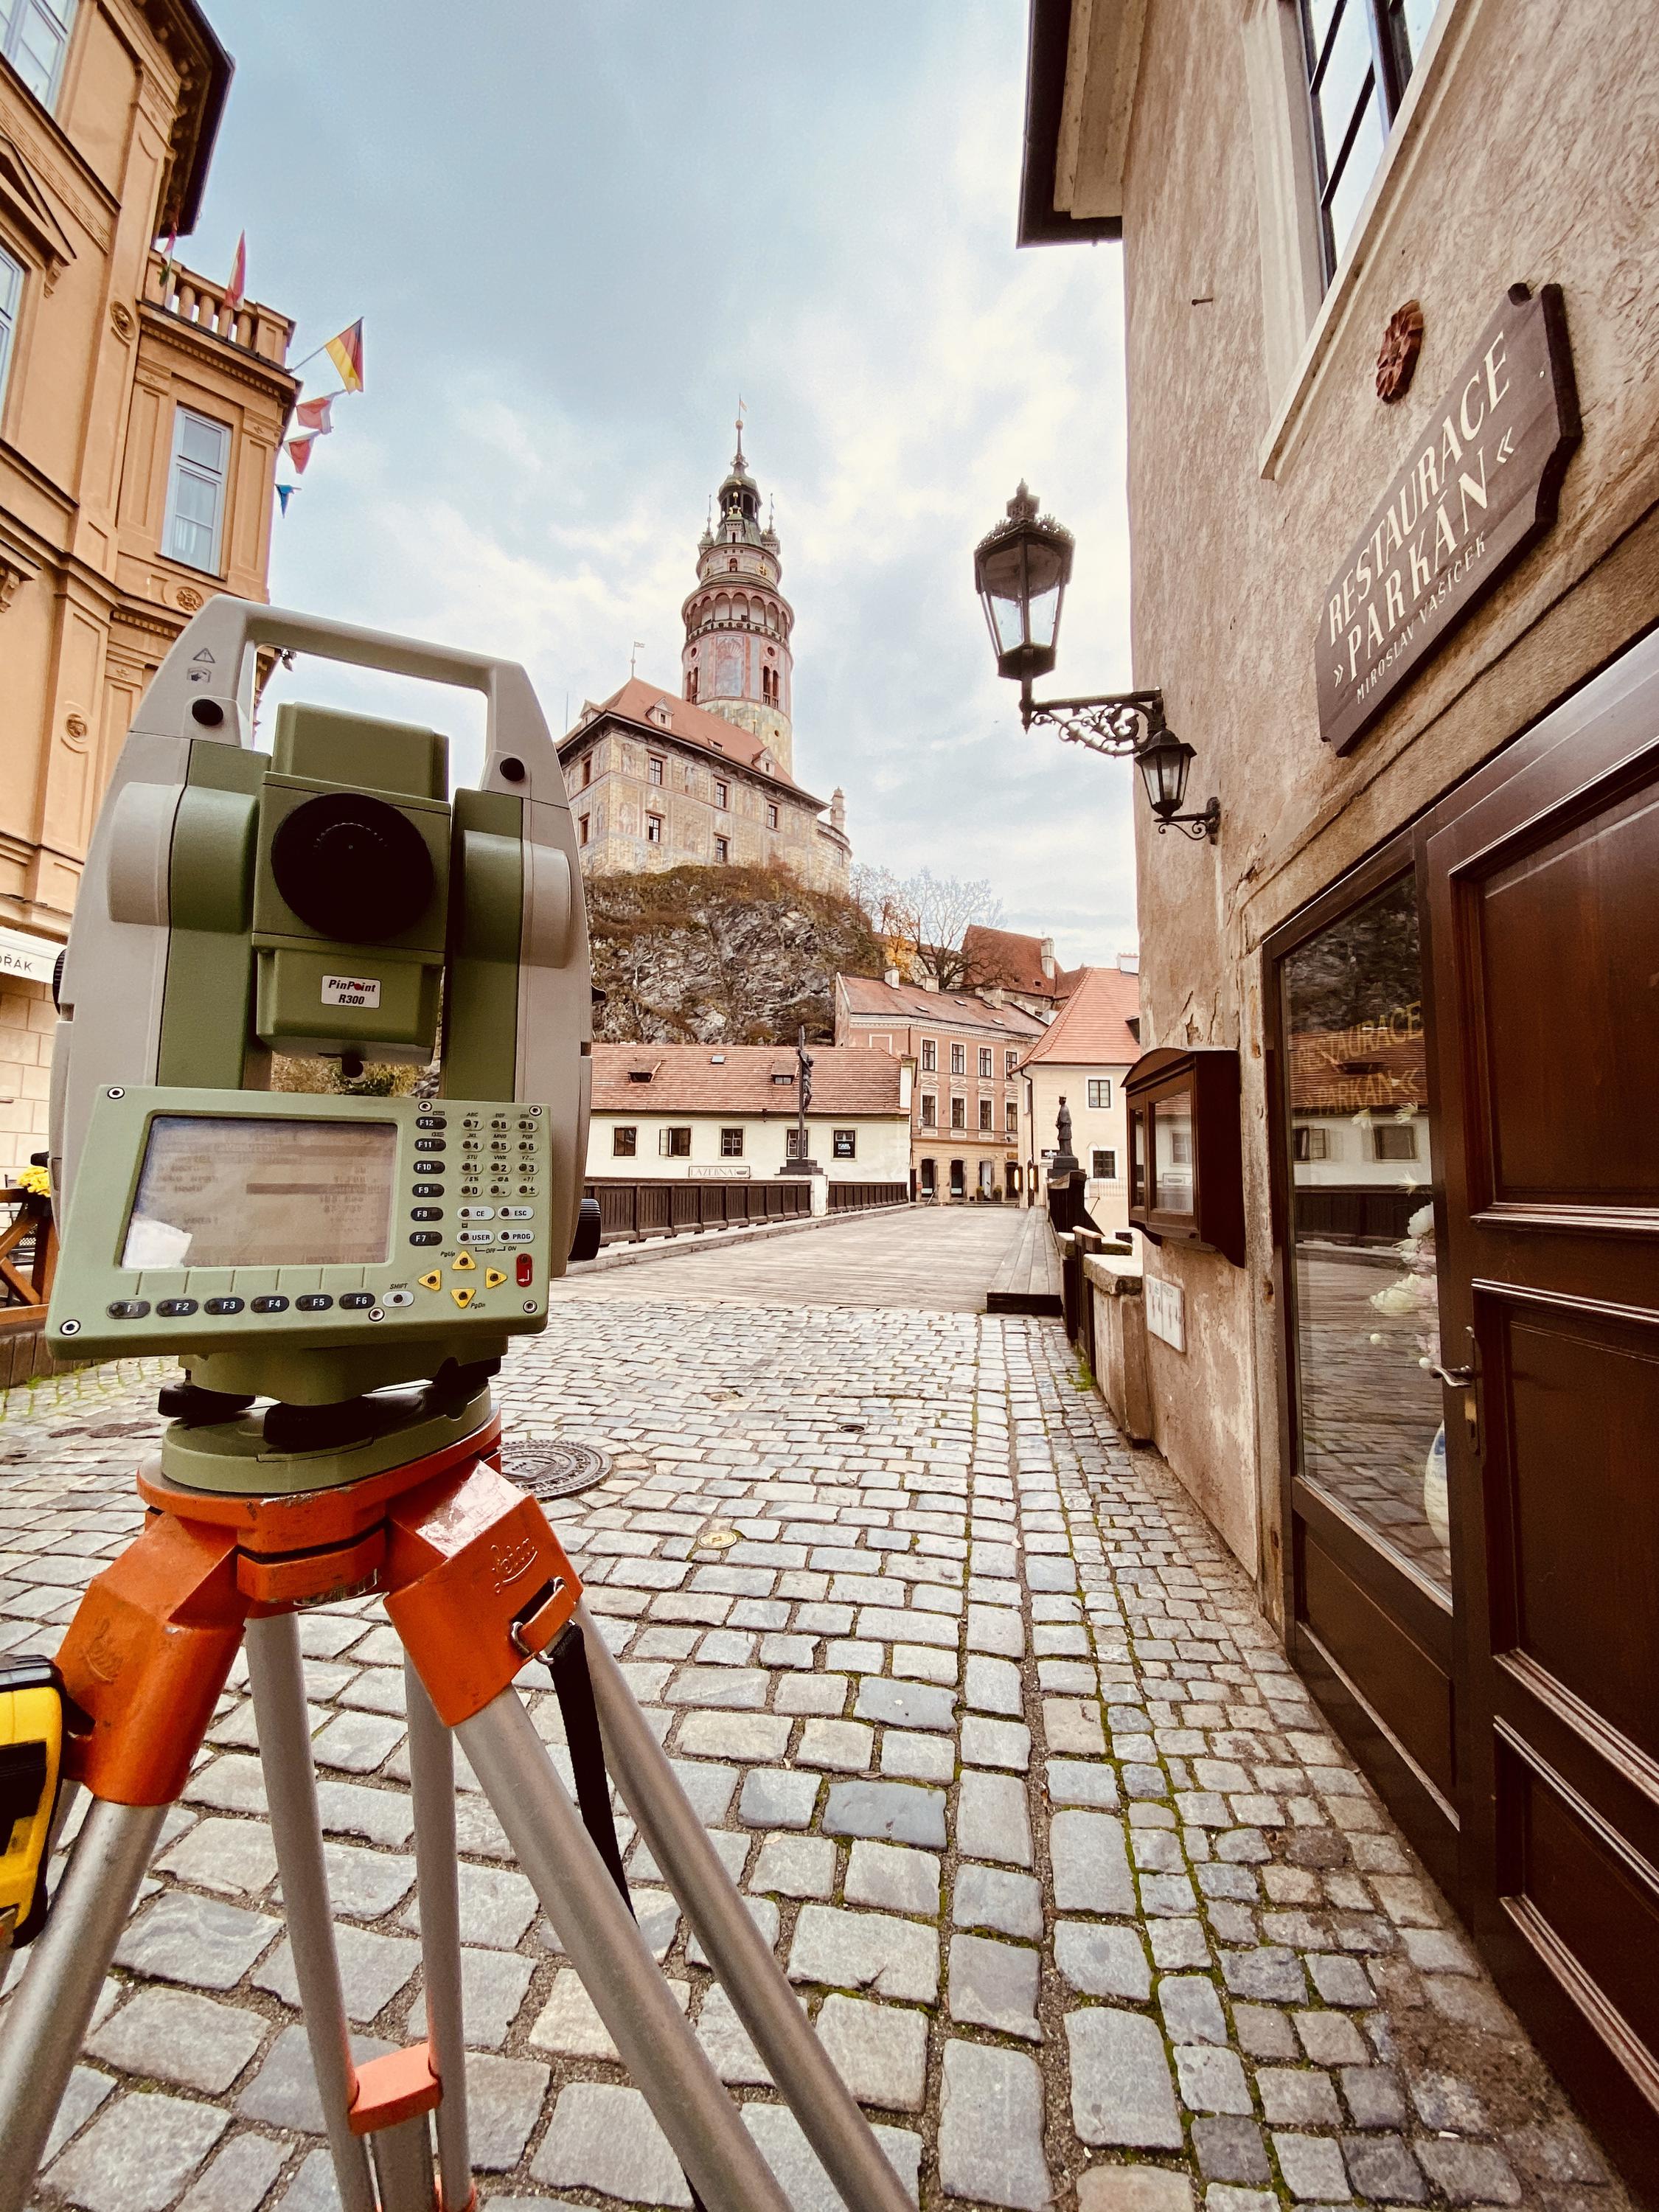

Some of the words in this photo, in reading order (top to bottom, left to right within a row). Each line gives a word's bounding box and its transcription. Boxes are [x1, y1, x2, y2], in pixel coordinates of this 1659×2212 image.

[1328, 330, 1510, 647] RESTAURACE
[1356, 619, 1415, 705] MIROSLAV
[0, 953, 32, 973] ŘÁK
[328, 979, 376, 992] PinPoint
[338, 994, 365, 1005] R300
[501, 1164, 507, 1172] 2
[472, 1186, 478, 1194] 0
[268, 1299, 281, 1308] F4
[313, 1298, 325, 1307] F5
[355, 1296, 367, 1305] F6
[126, 1304, 139, 1313] F1
[175, 1302, 189, 1311] F2
[223, 1301, 236, 1310] F3
